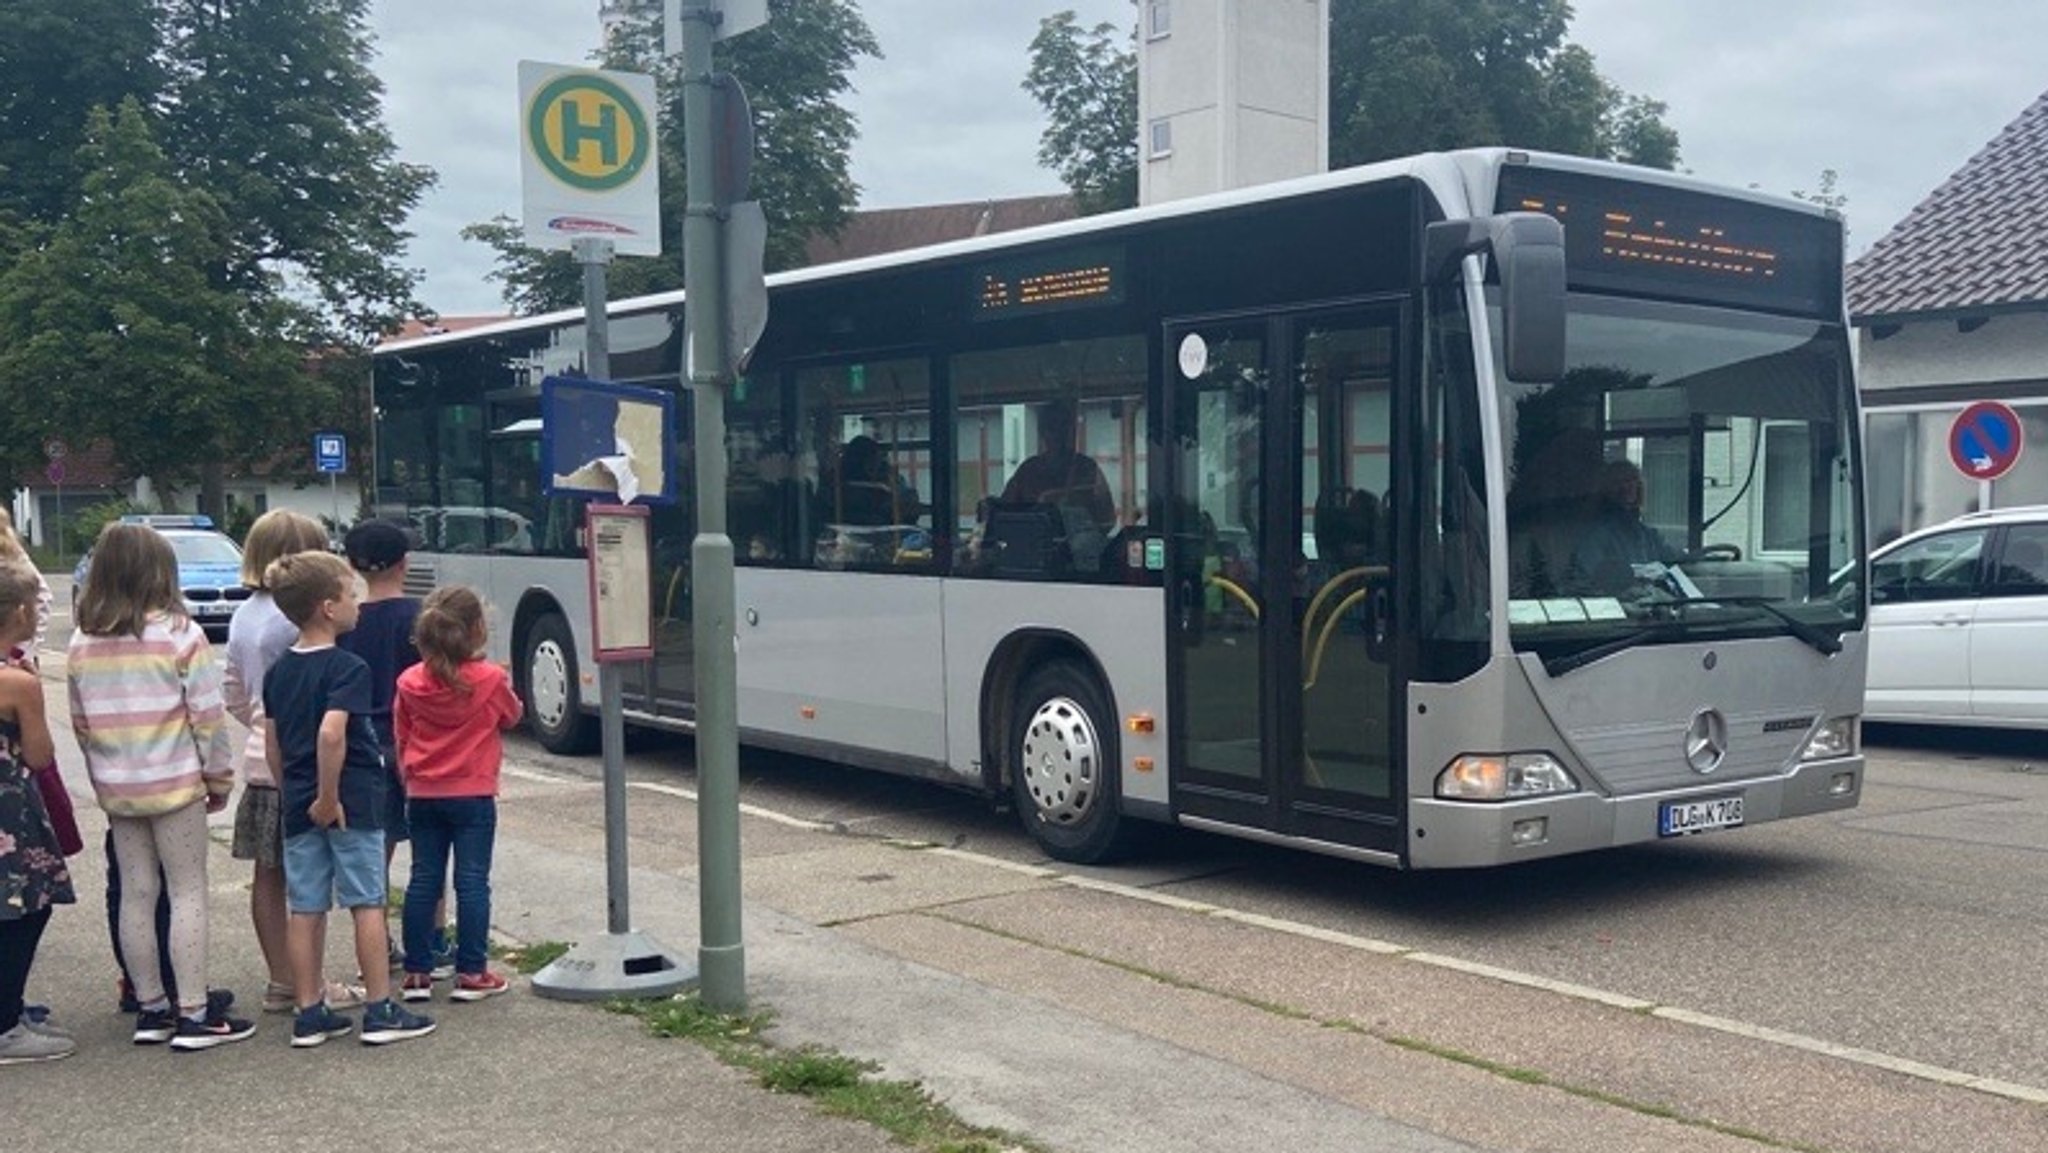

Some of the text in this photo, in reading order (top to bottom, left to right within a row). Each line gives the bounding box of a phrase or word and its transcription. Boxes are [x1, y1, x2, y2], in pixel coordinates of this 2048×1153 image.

[560, 100, 618, 166] H
[1672, 805, 1697, 829] DLG
[1706, 802, 1716, 824] K
